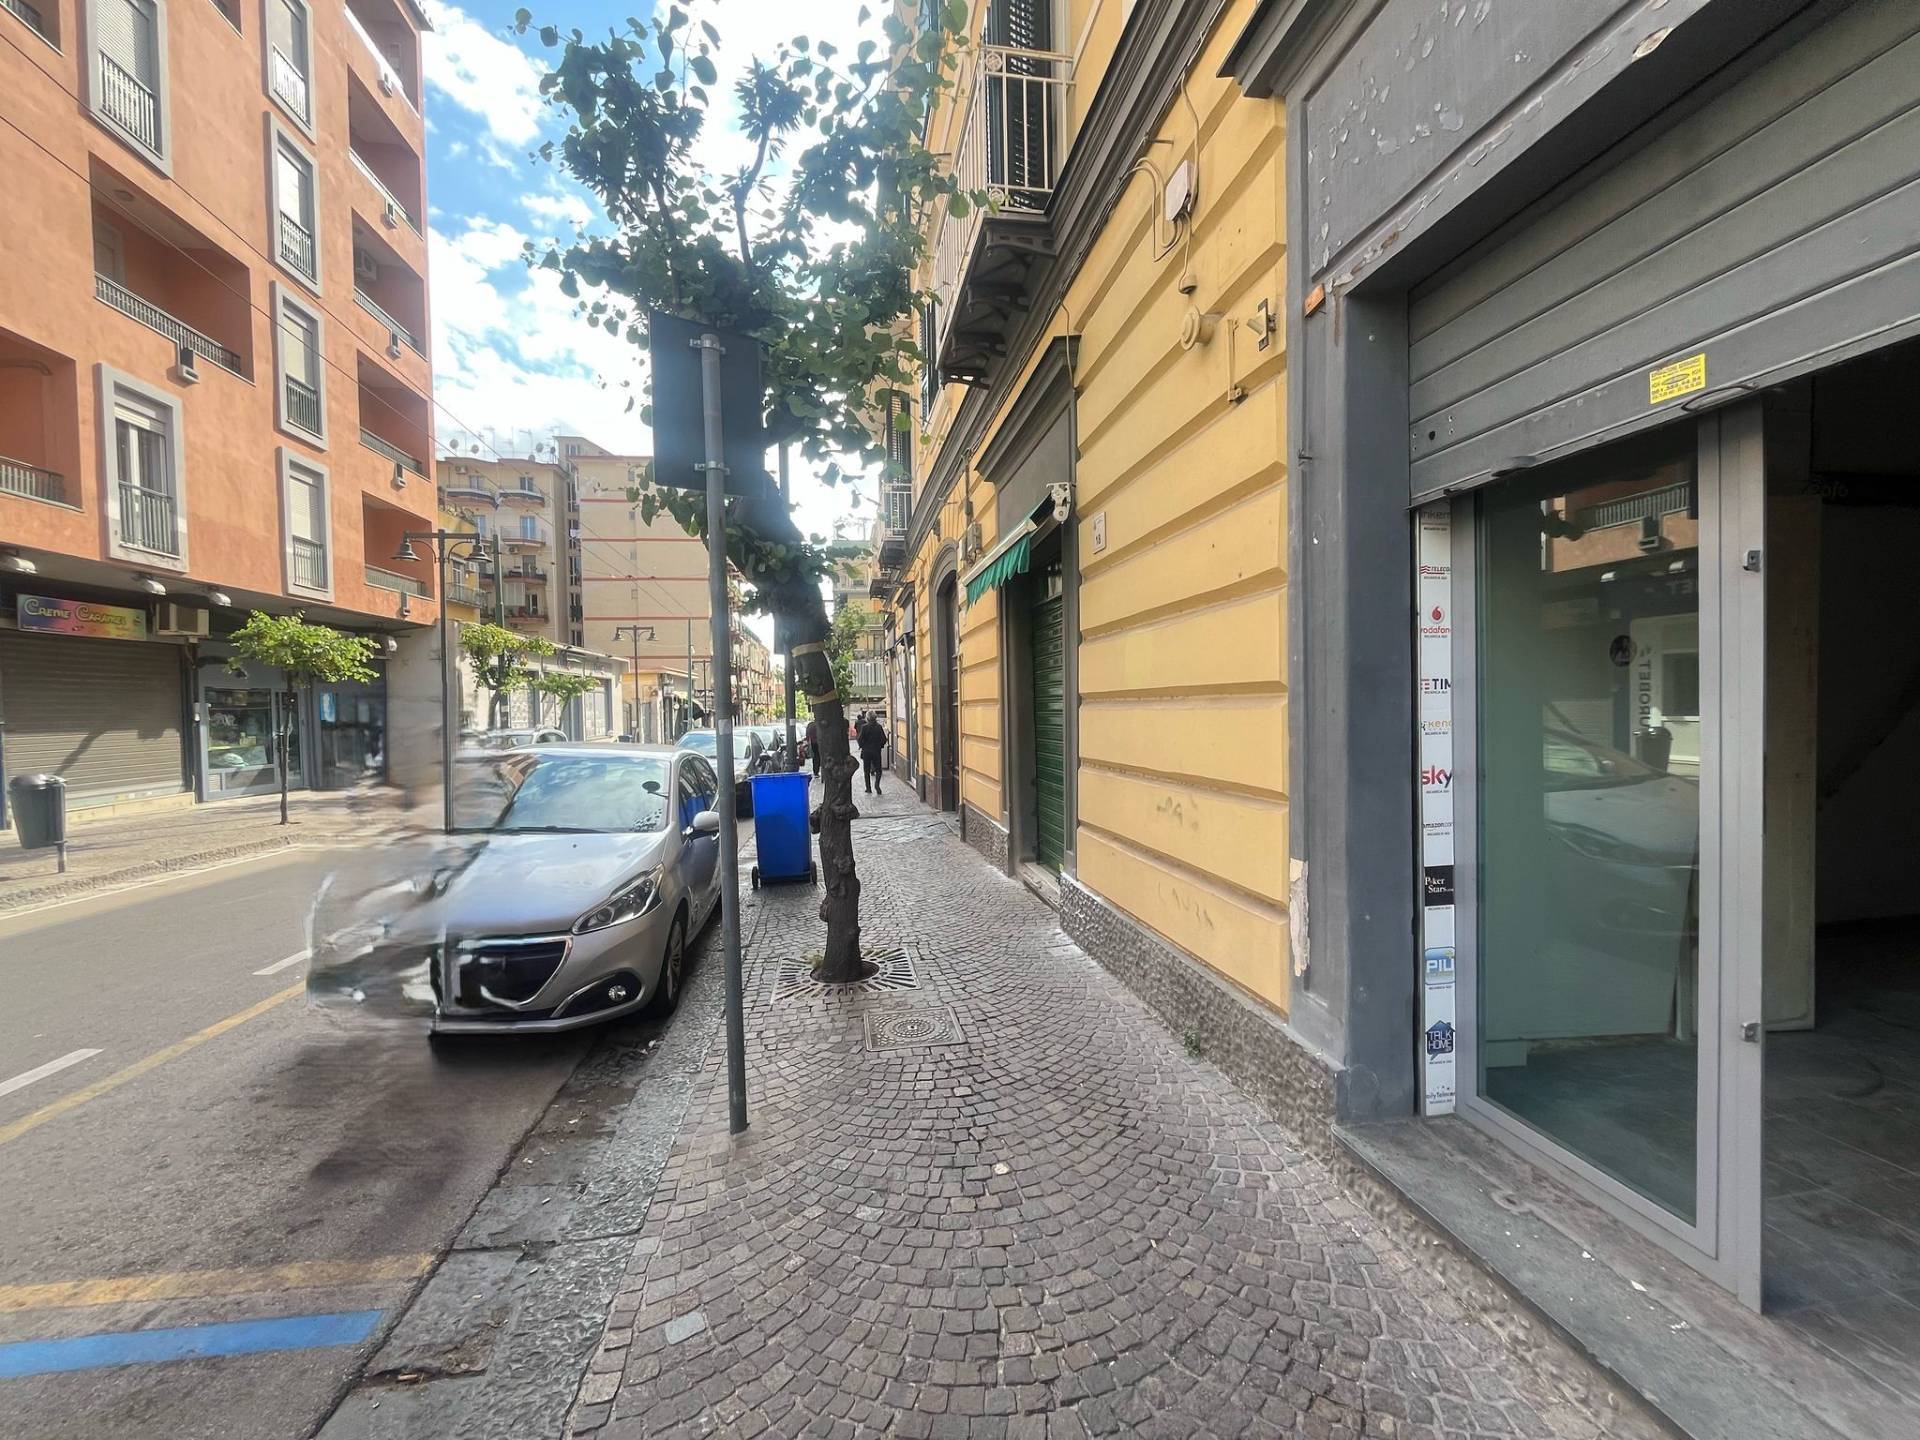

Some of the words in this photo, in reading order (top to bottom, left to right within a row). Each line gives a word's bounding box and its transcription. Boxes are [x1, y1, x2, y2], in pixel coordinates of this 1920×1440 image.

[1421, 765, 1453, 788] sky
[1428, 1030, 1452, 1040] TALK
[1428, 1040, 1452, 1050] HOME
